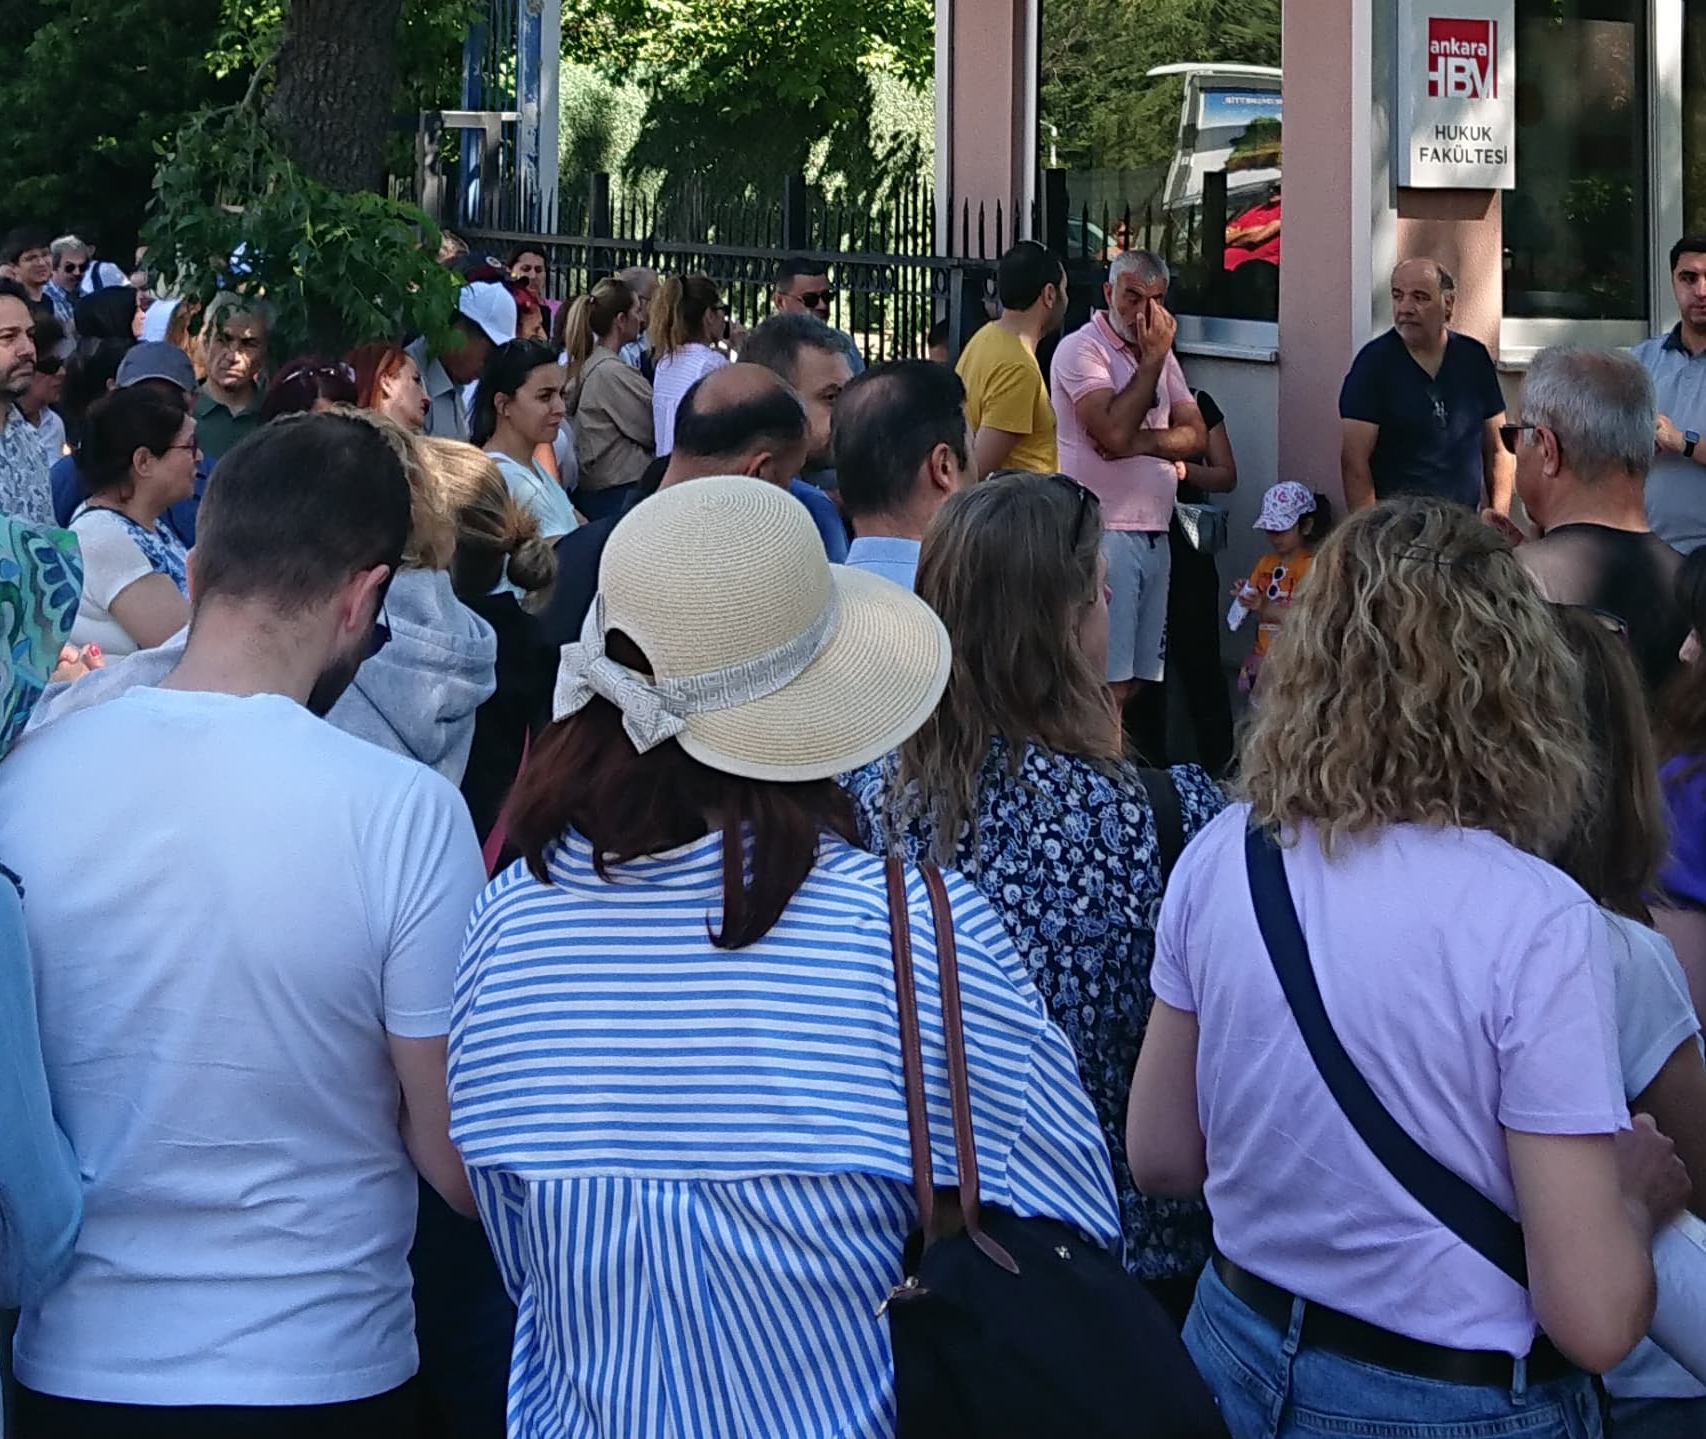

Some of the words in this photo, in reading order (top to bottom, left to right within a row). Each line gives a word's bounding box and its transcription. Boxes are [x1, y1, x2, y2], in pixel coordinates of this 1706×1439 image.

[1430, 37, 1488, 57] ankara
[1434, 124, 1493, 142] HUKUK
[1419, 144, 1508, 165] FAKÜLTESİ
